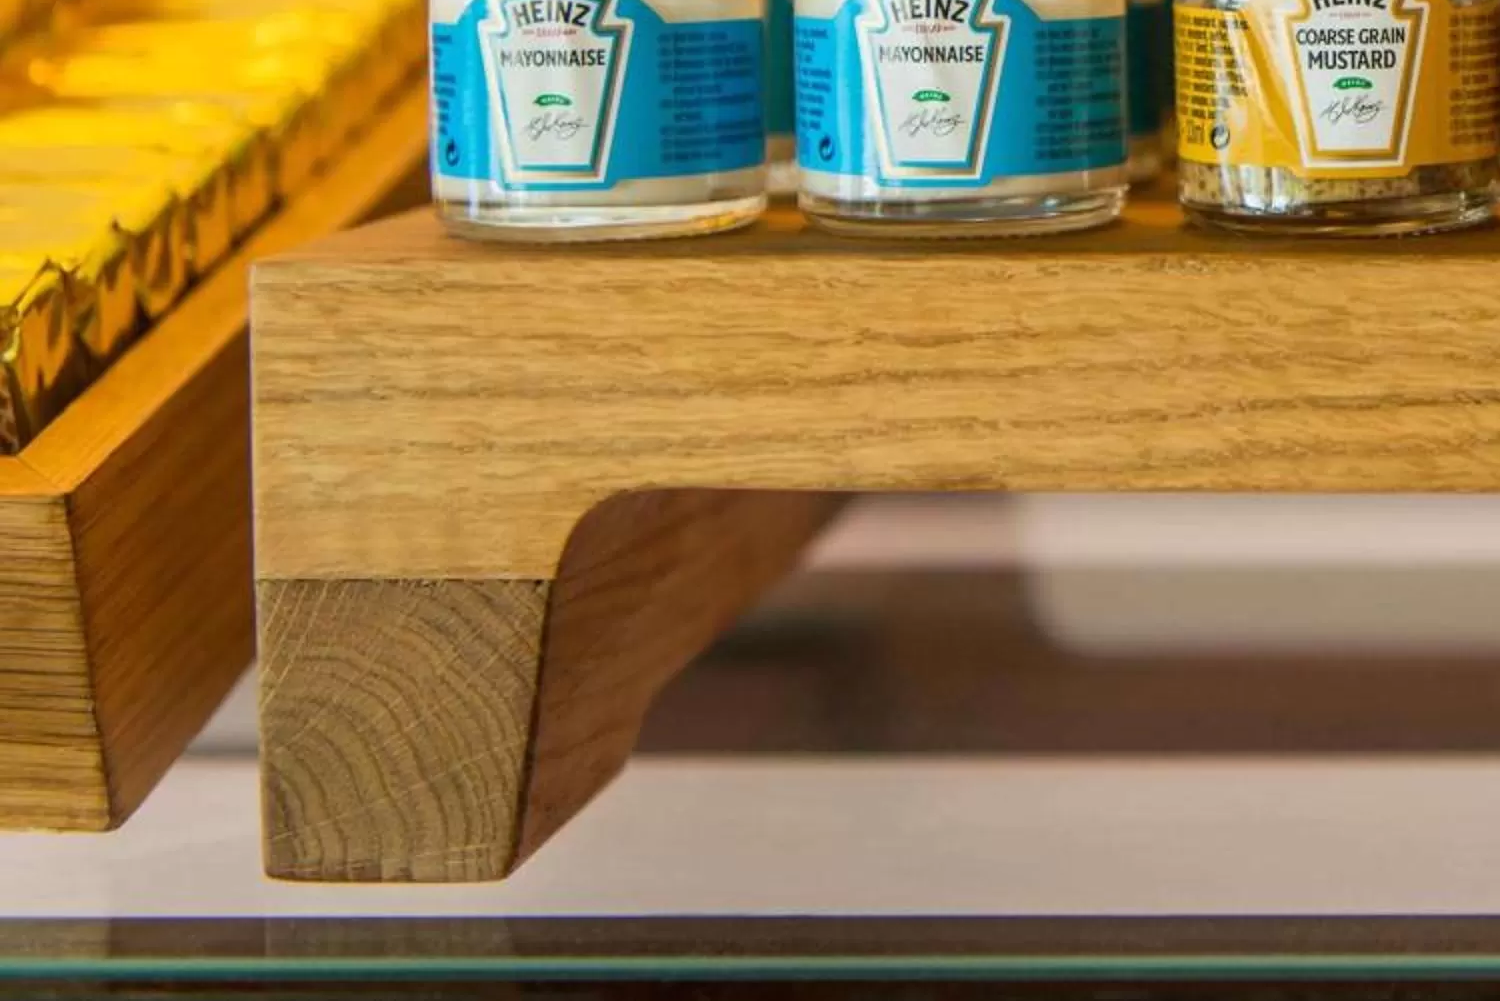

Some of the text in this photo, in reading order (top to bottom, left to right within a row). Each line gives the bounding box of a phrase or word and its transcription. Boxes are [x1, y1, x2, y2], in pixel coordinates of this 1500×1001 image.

[513, 0, 591, 27] HEINZ
[1296, 26, 1406, 46] COARSE GRAIN
[501, 47, 606, 68] MAYONNAISE
[879, 44, 984, 64] MAYONNAISE
[1307, 49, 1397, 71] MUSTARD
